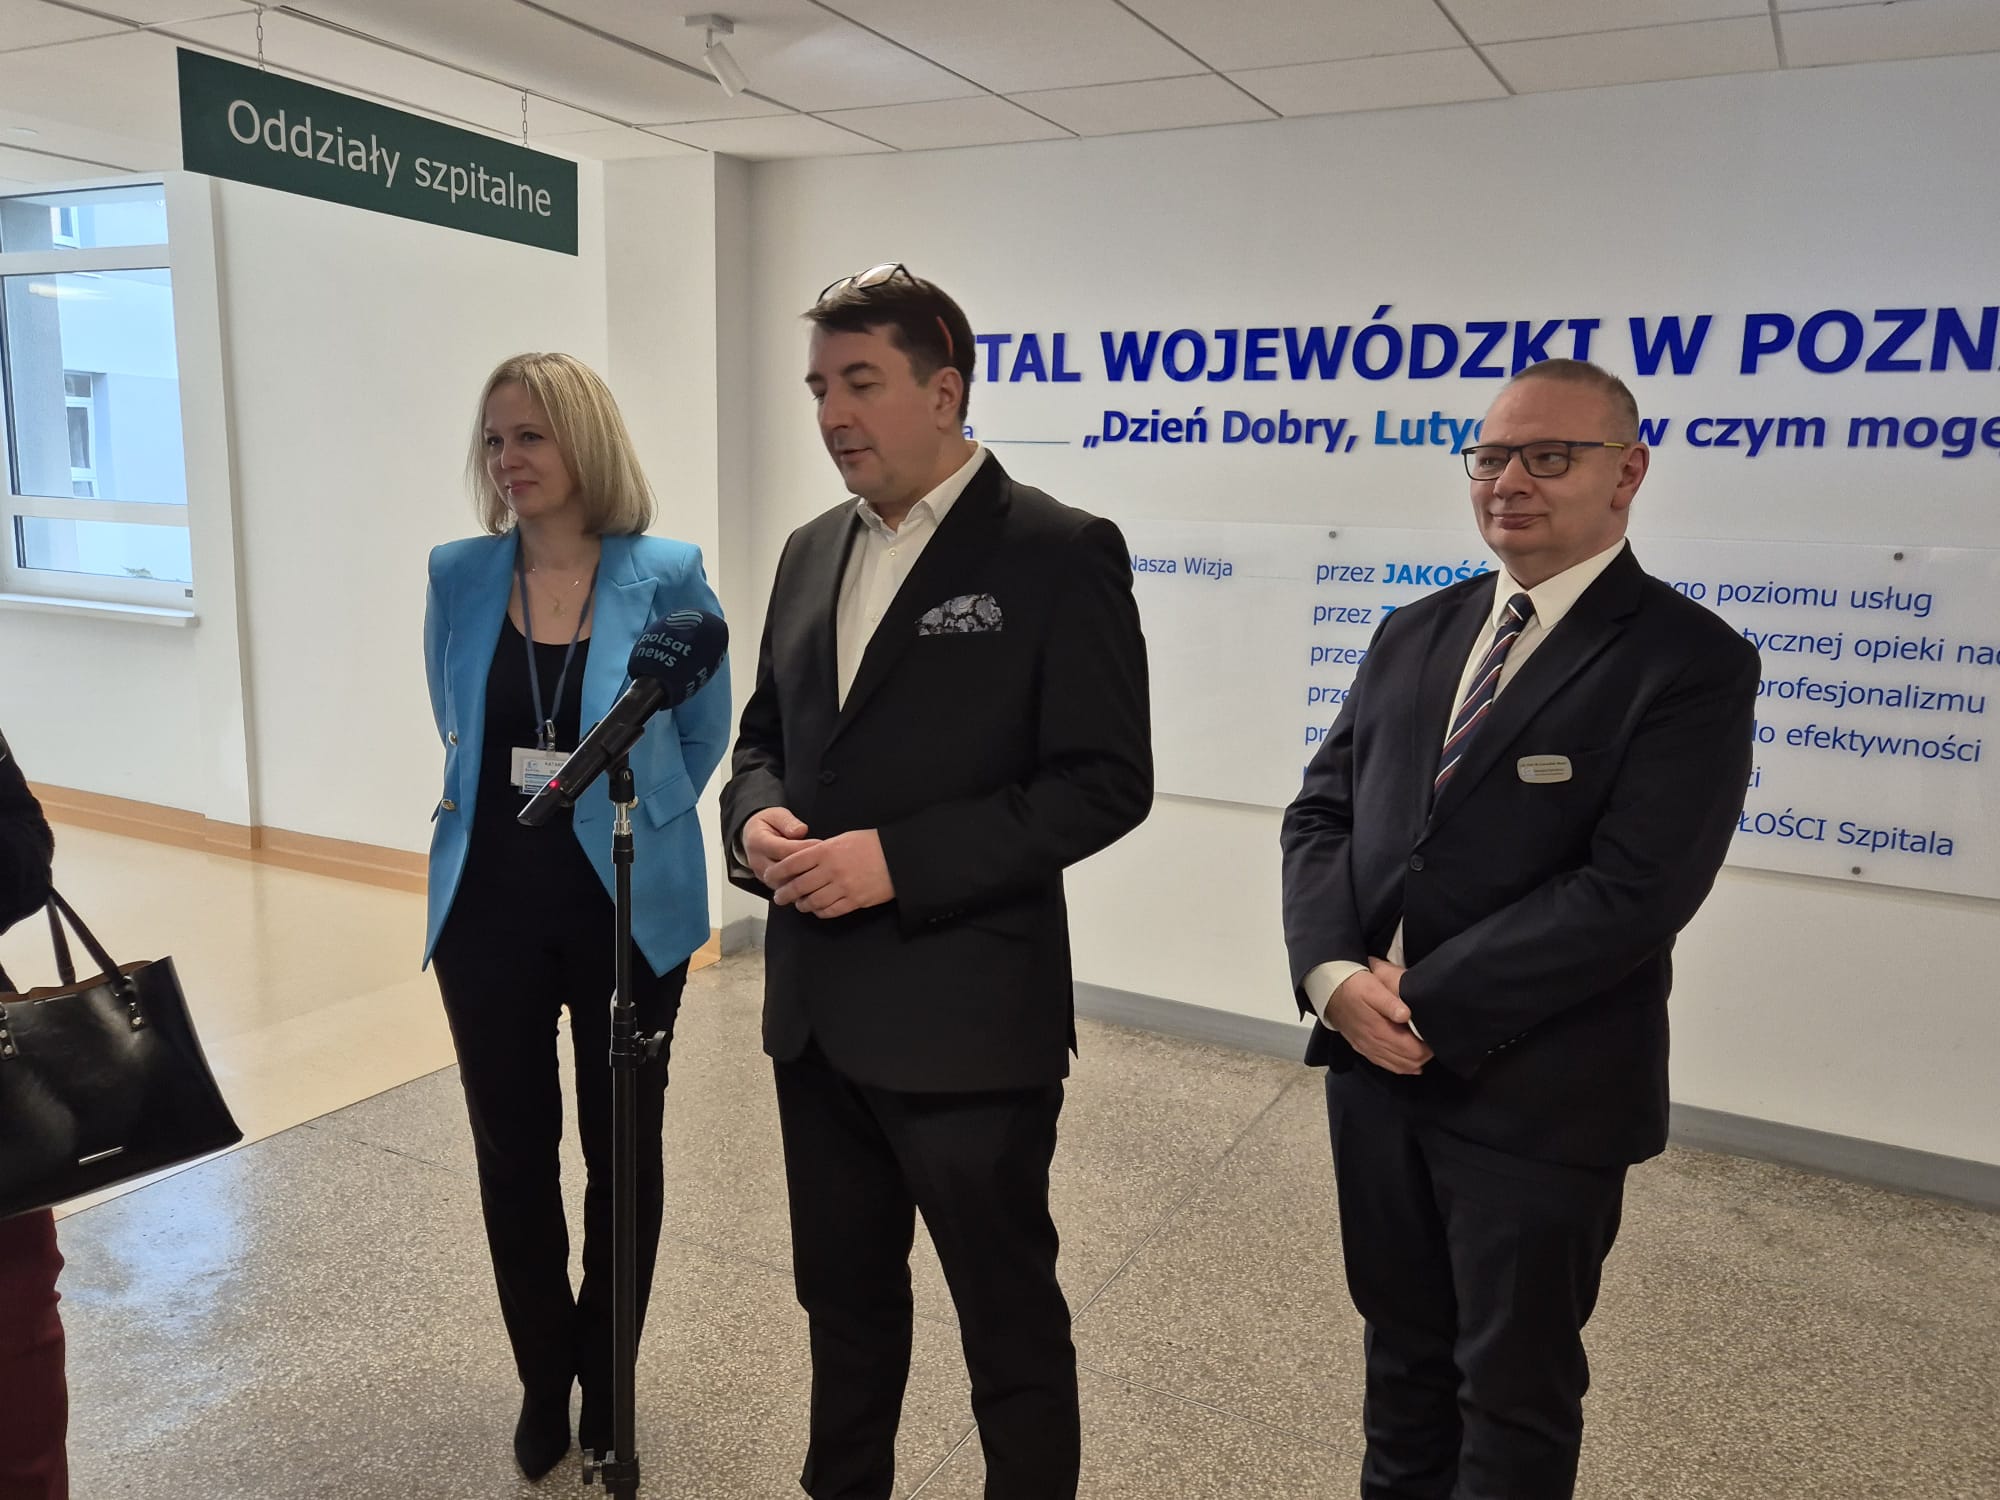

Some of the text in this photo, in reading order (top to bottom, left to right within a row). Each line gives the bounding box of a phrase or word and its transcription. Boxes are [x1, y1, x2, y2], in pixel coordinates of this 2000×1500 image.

[228, 100, 551, 217] Oddziały szpitalne
[972, 305, 2000, 382] TAL WOJEWÓDZKI W POZN
[1223, 409, 1358, 453] Dobry,
[1686, 417, 1826, 458] czym
[1184, 557, 1233, 580] Wizja
[1316, 564, 1376, 585] przez
[1717, 581, 1838, 607] poziomu
[1850, 586, 1933, 617] usług
[636, 646, 677, 668] news
[639, 632, 692, 657] polsat
[1313, 605, 1372, 626] przez
[1742, 627, 1843, 661] tycznej
[1854, 635, 1945, 663] opieki
[1786, 724, 1981, 763] efektywności
[1737, 808, 1954, 856] ŁOŚCI Szpitala
